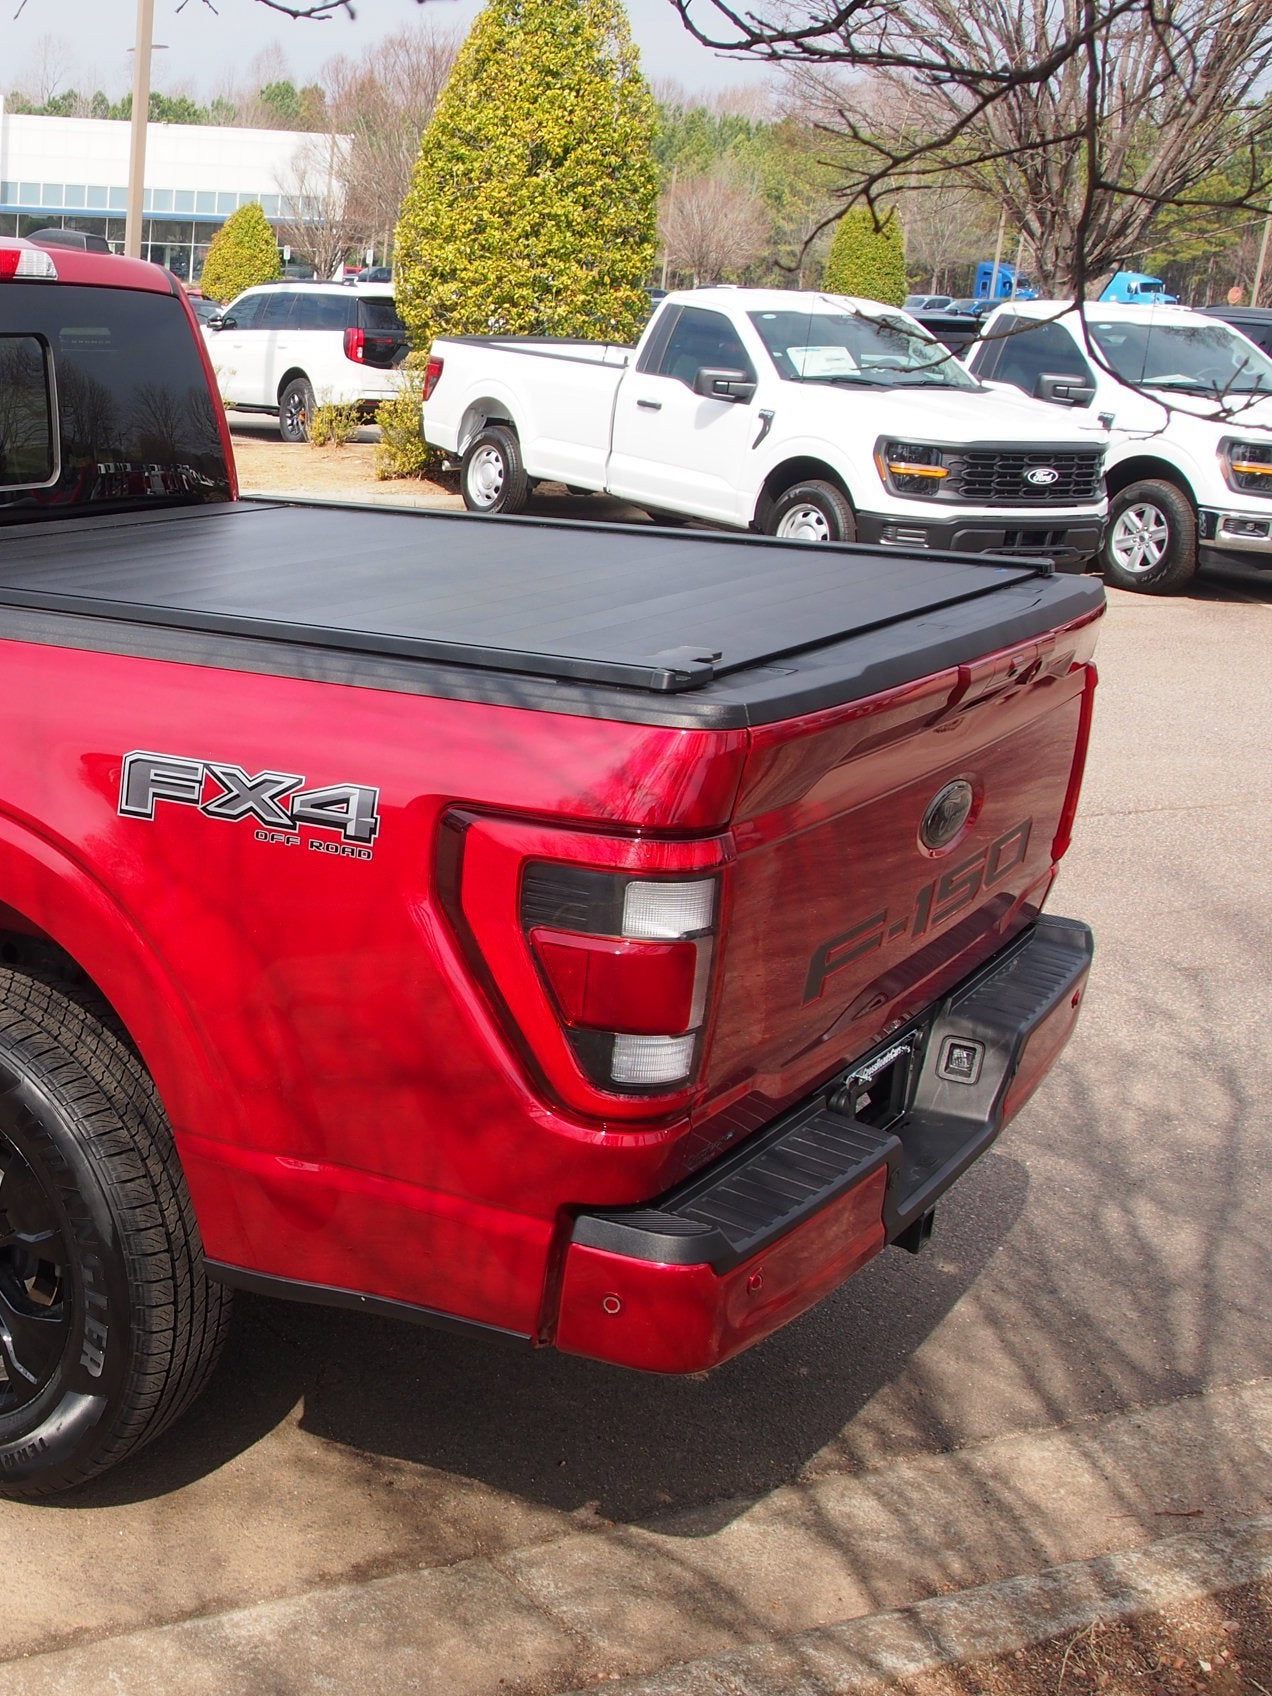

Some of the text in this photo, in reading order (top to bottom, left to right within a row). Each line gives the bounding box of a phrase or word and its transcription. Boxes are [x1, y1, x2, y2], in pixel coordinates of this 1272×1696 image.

[117, 749, 380, 846] FX4
[254, 830, 373, 861] OFF ROAD
[801, 816, 1033, 1009] F-150
